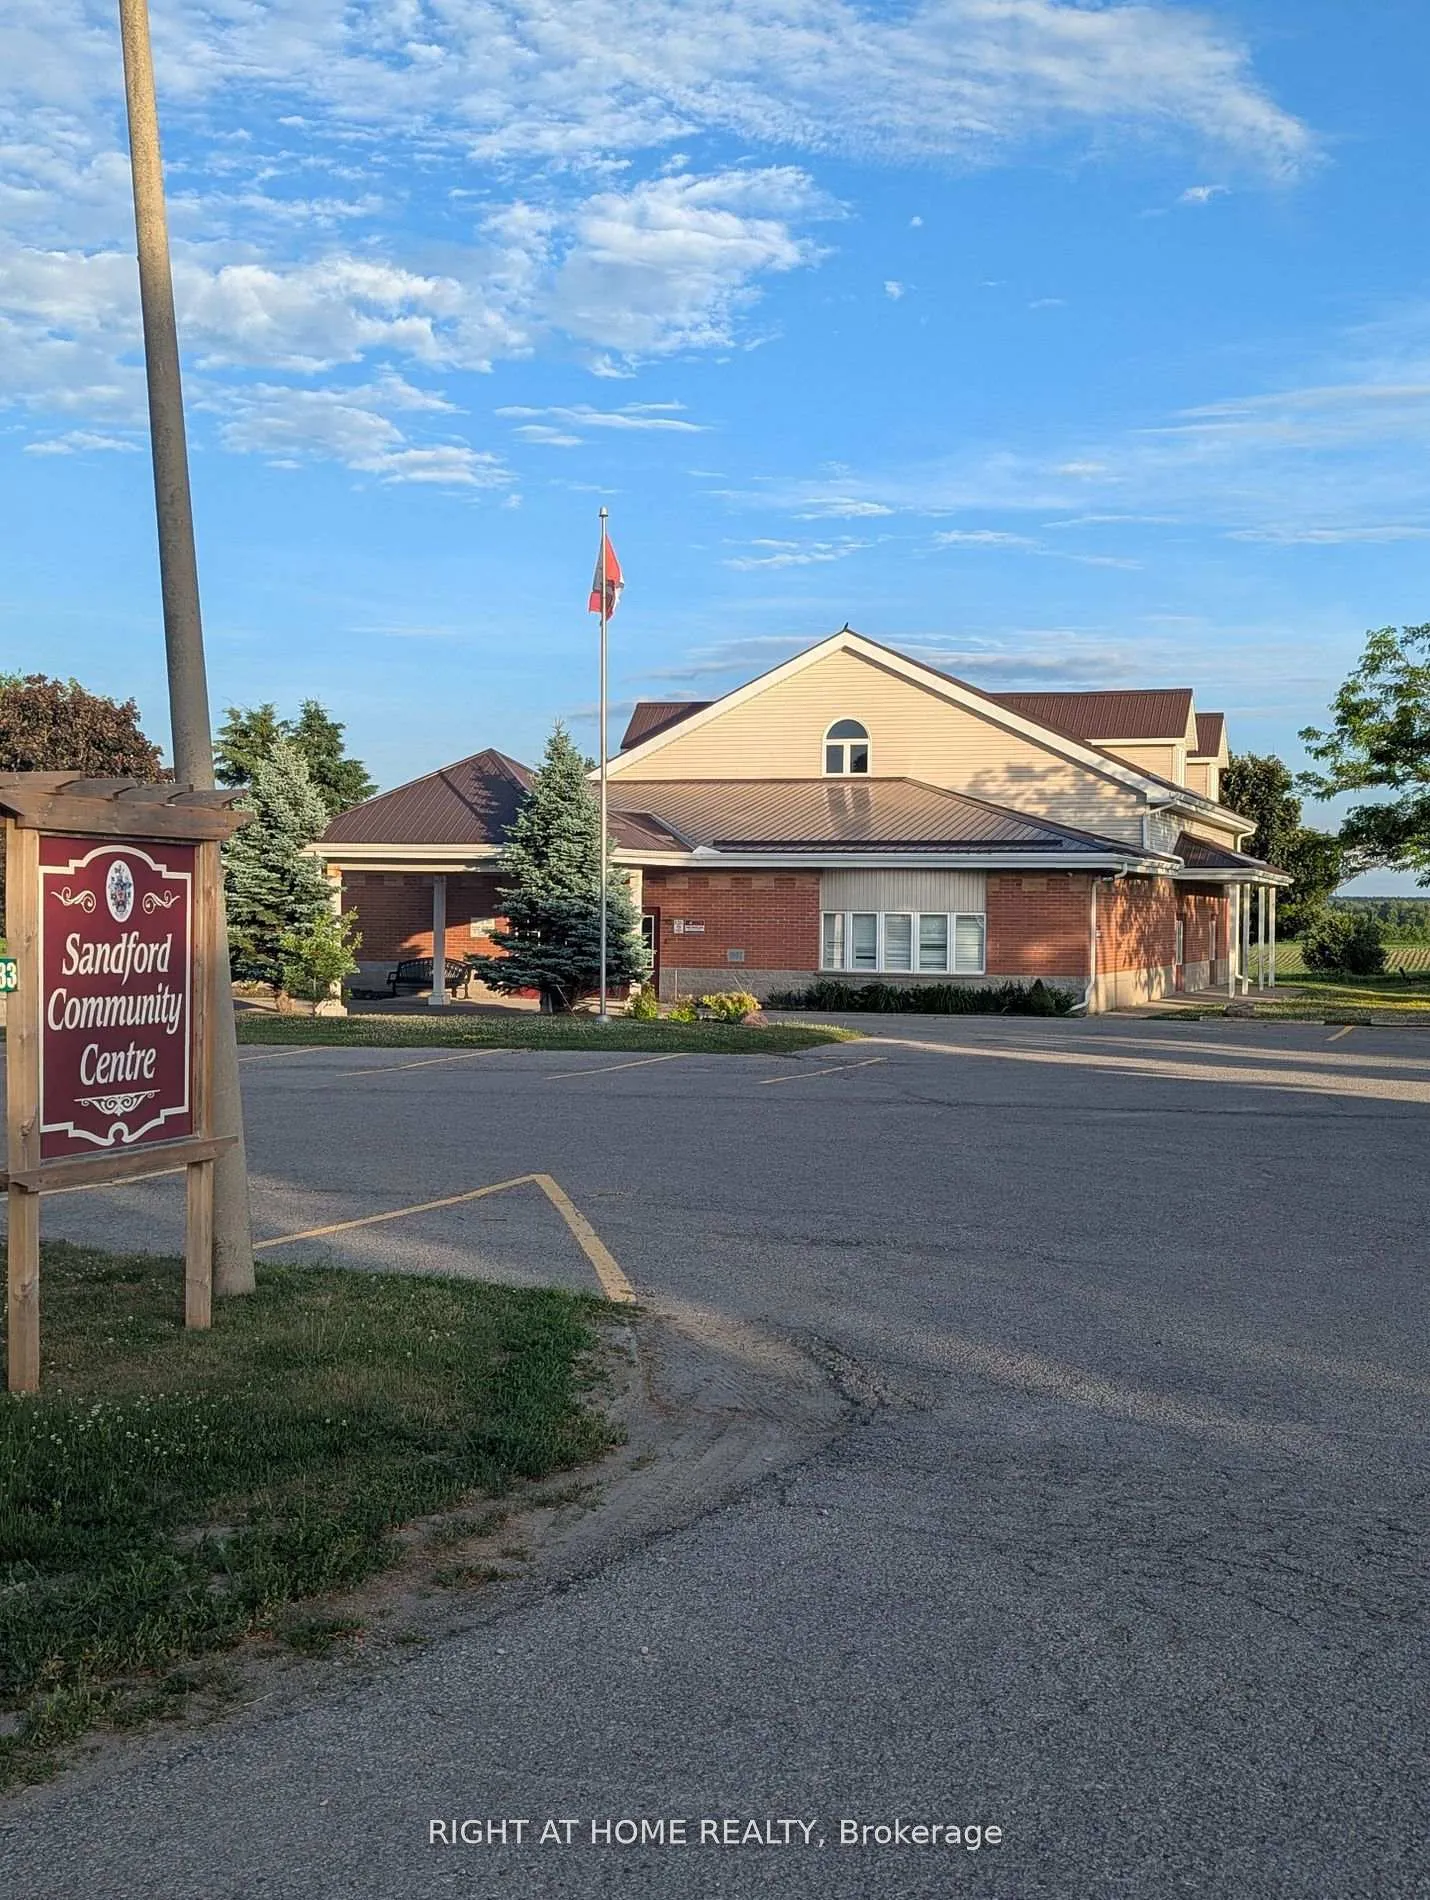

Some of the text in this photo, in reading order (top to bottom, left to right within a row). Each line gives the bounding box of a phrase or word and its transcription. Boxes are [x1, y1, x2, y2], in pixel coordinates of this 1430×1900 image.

[62, 931, 173, 985] Sandford
[48, 983, 182, 1034] Community
[80, 1041, 157, 1085] Centre
